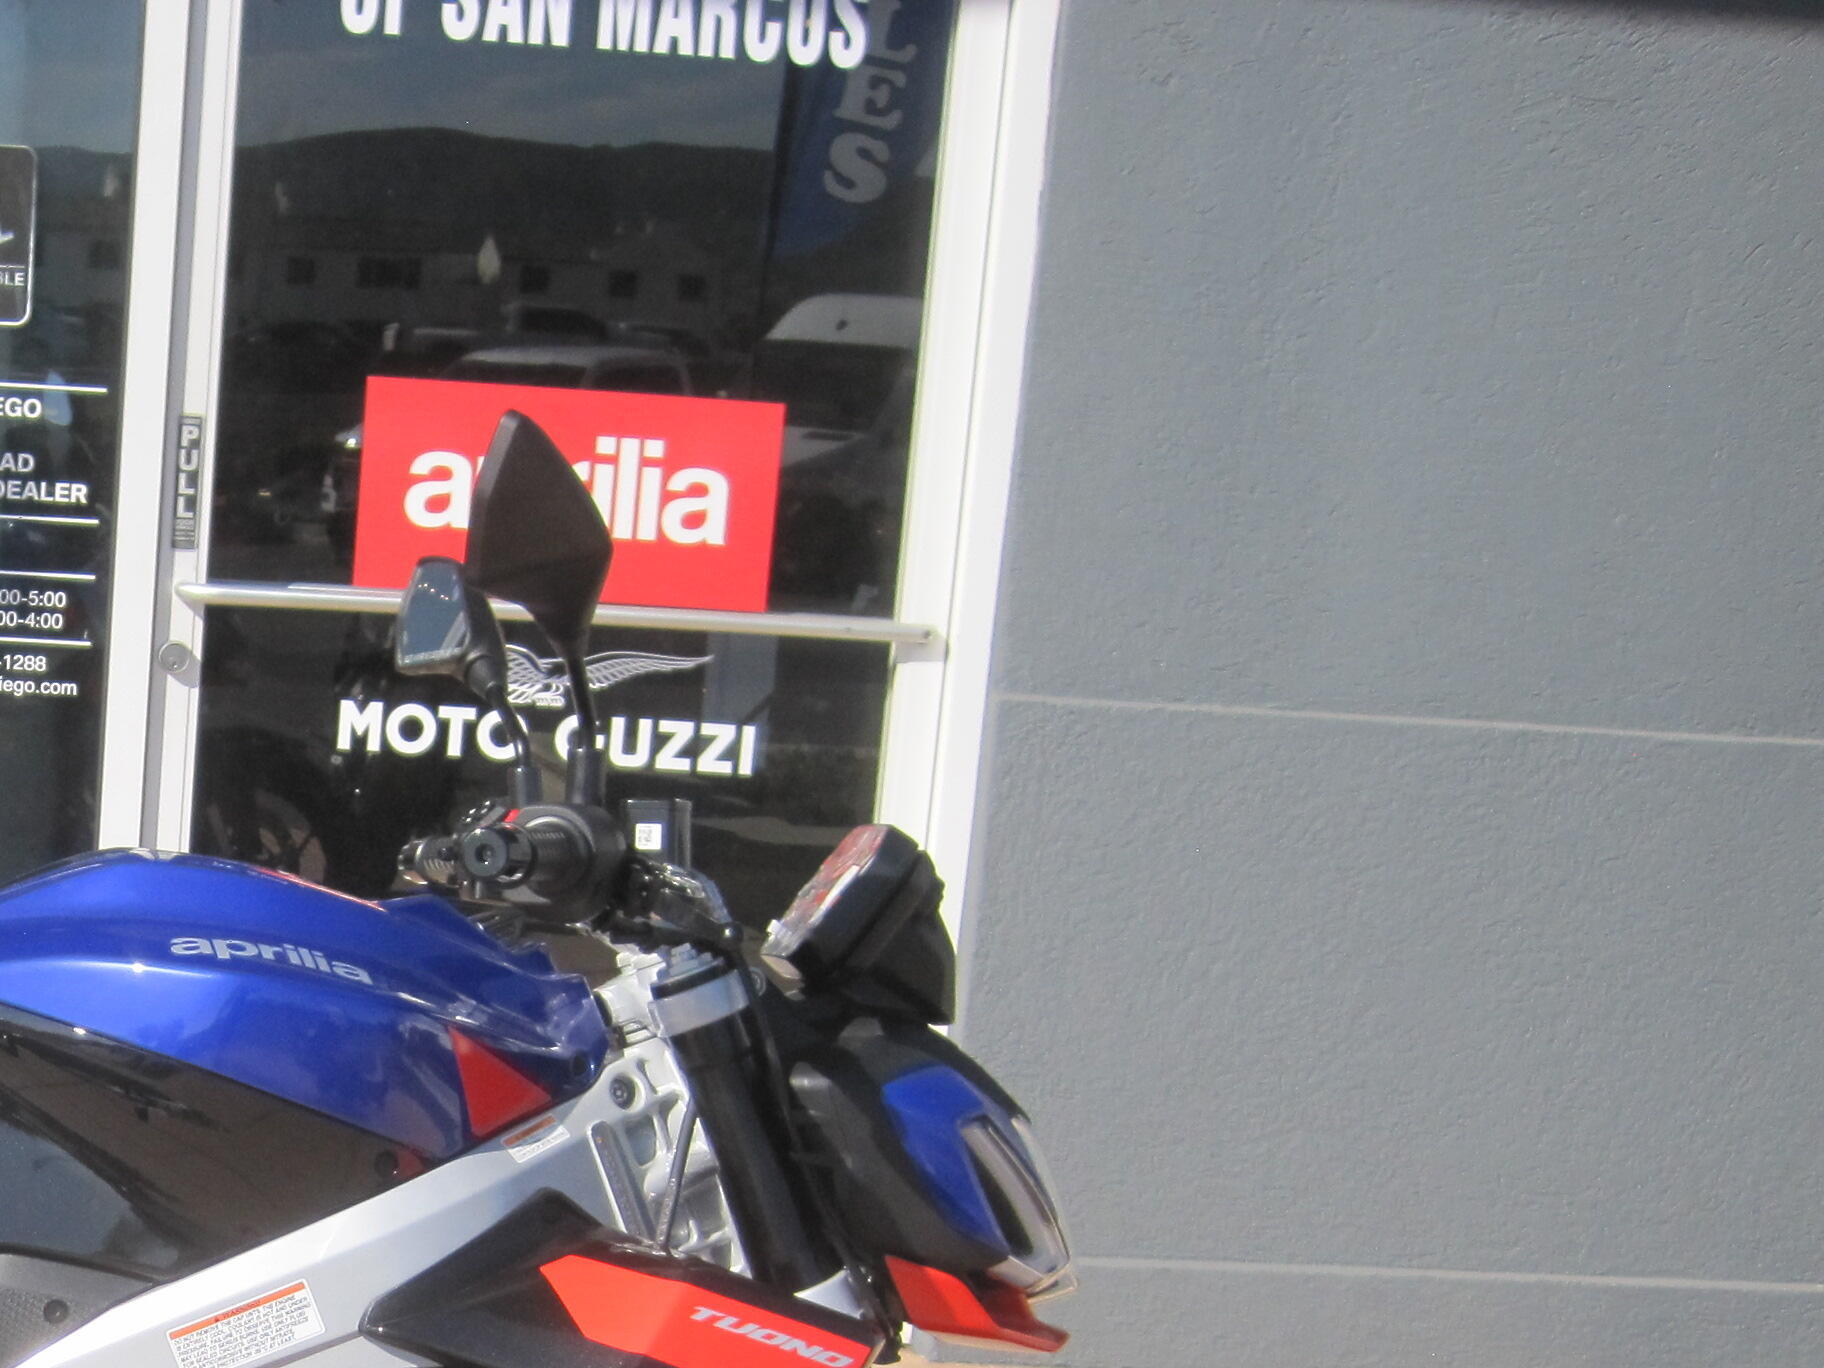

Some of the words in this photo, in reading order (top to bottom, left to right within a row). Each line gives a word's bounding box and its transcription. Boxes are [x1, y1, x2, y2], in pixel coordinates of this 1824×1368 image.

[176, 425, 200, 518] PULL
[403, 435, 730, 546] ailia
[336, 698, 529, 762] MOTO
[170, 937, 373, 985] aprilia
[690, 1305, 854, 1368] TUONO
